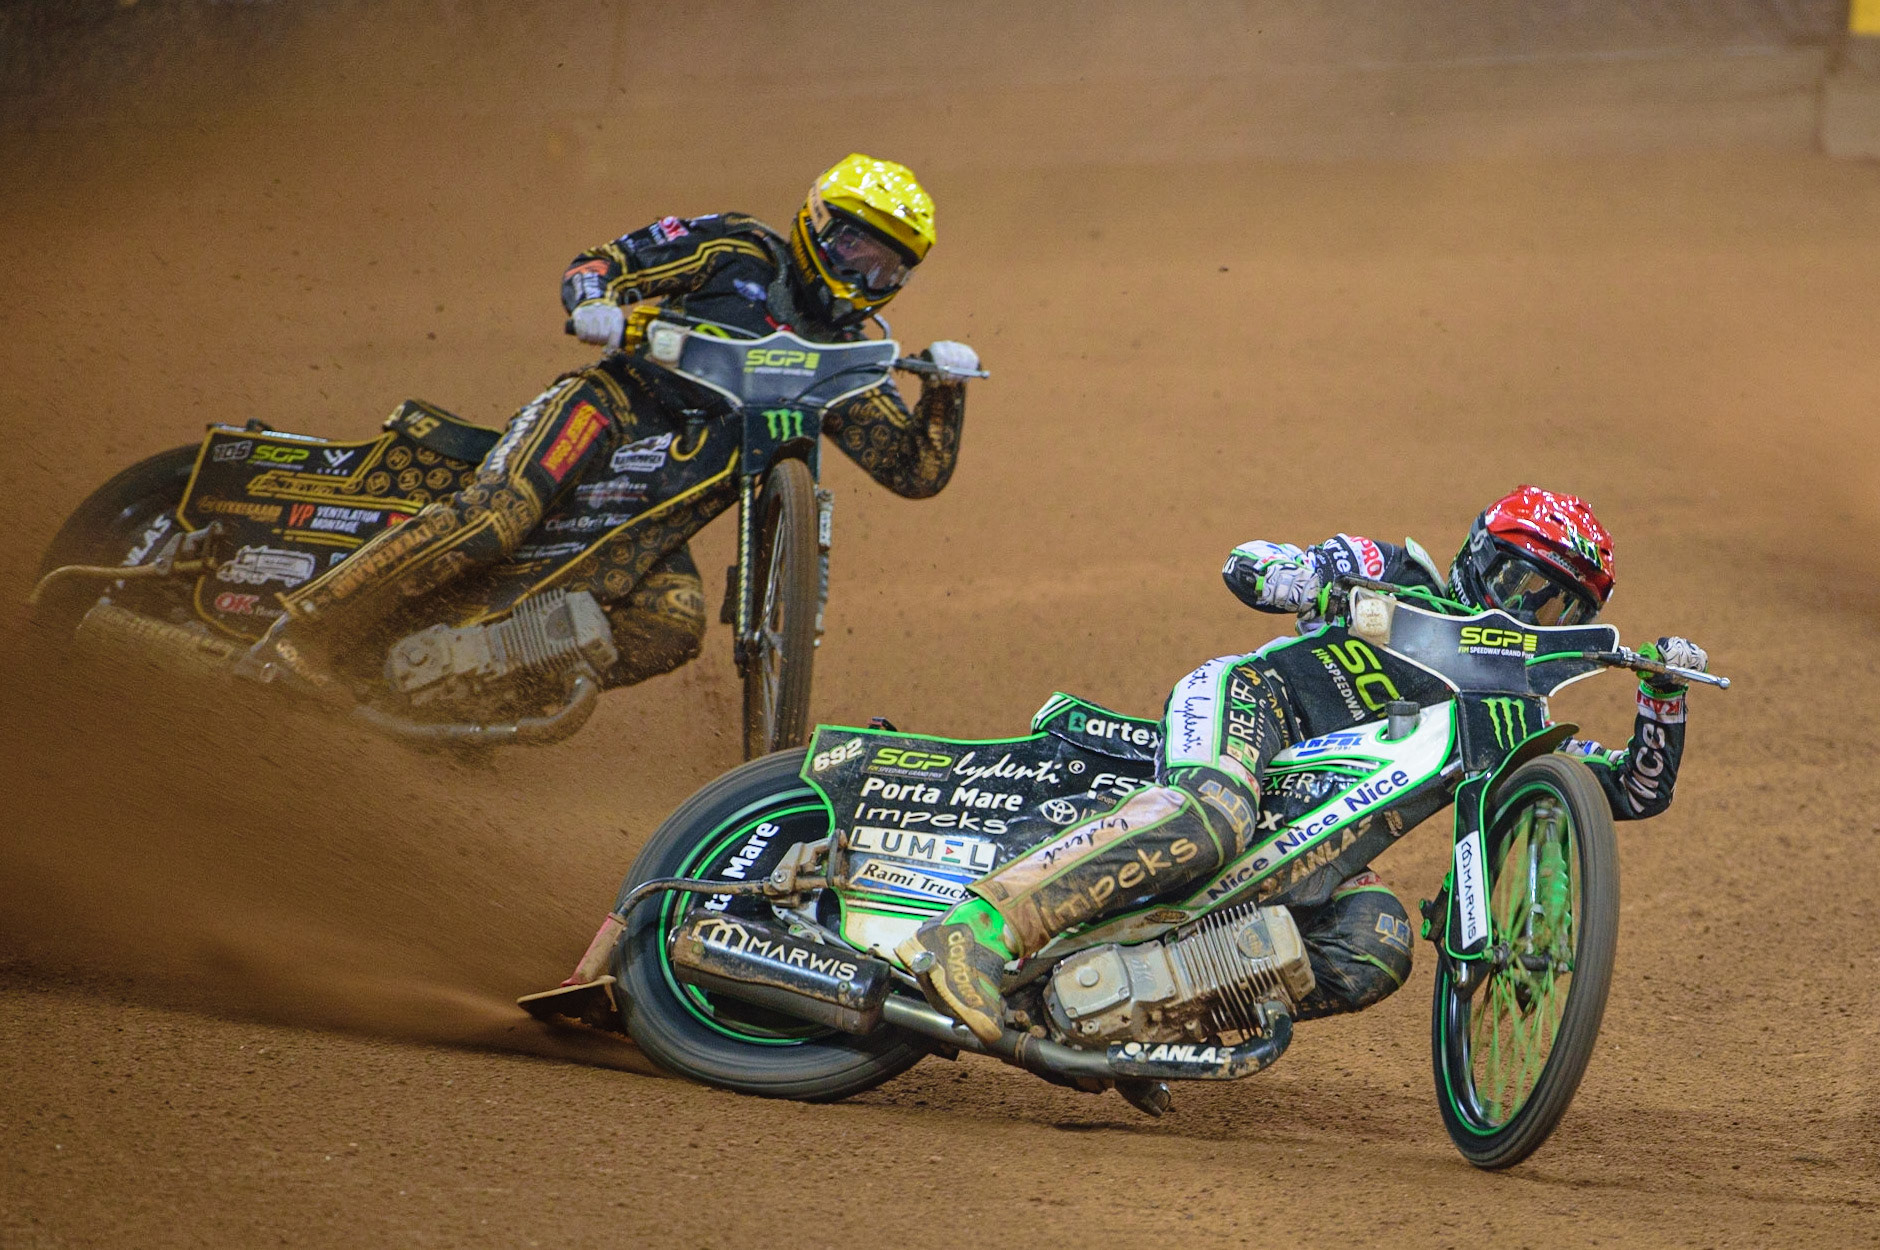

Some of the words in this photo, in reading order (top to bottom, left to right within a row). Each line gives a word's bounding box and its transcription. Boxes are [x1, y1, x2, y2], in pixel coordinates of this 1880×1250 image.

[252, 445, 311, 463] SGP
[288, 503, 316, 527] VP
[1470, 646, 1501, 656] SPEEDWAY
[1501, 648, 1521, 657] GRAND
[812, 738, 864, 773] 692
[872, 747, 953, 771] SGP
[860, 777, 942, 803] Porta
[950, 783, 1023, 812] Mare
[1343, 769, 1409, 813] Nice
[854, 802, 1009, 836] Impeks
[1274, 812, 1340, 856] Nice
[722, 822, 780, 879] Mare
[863, 864, 916, 886] Rami
[1206, 856, 1270, 901] Nice
[1463, 868, 1477, 940] MARWIS
[747, 936, 858, 982] MARWIS
